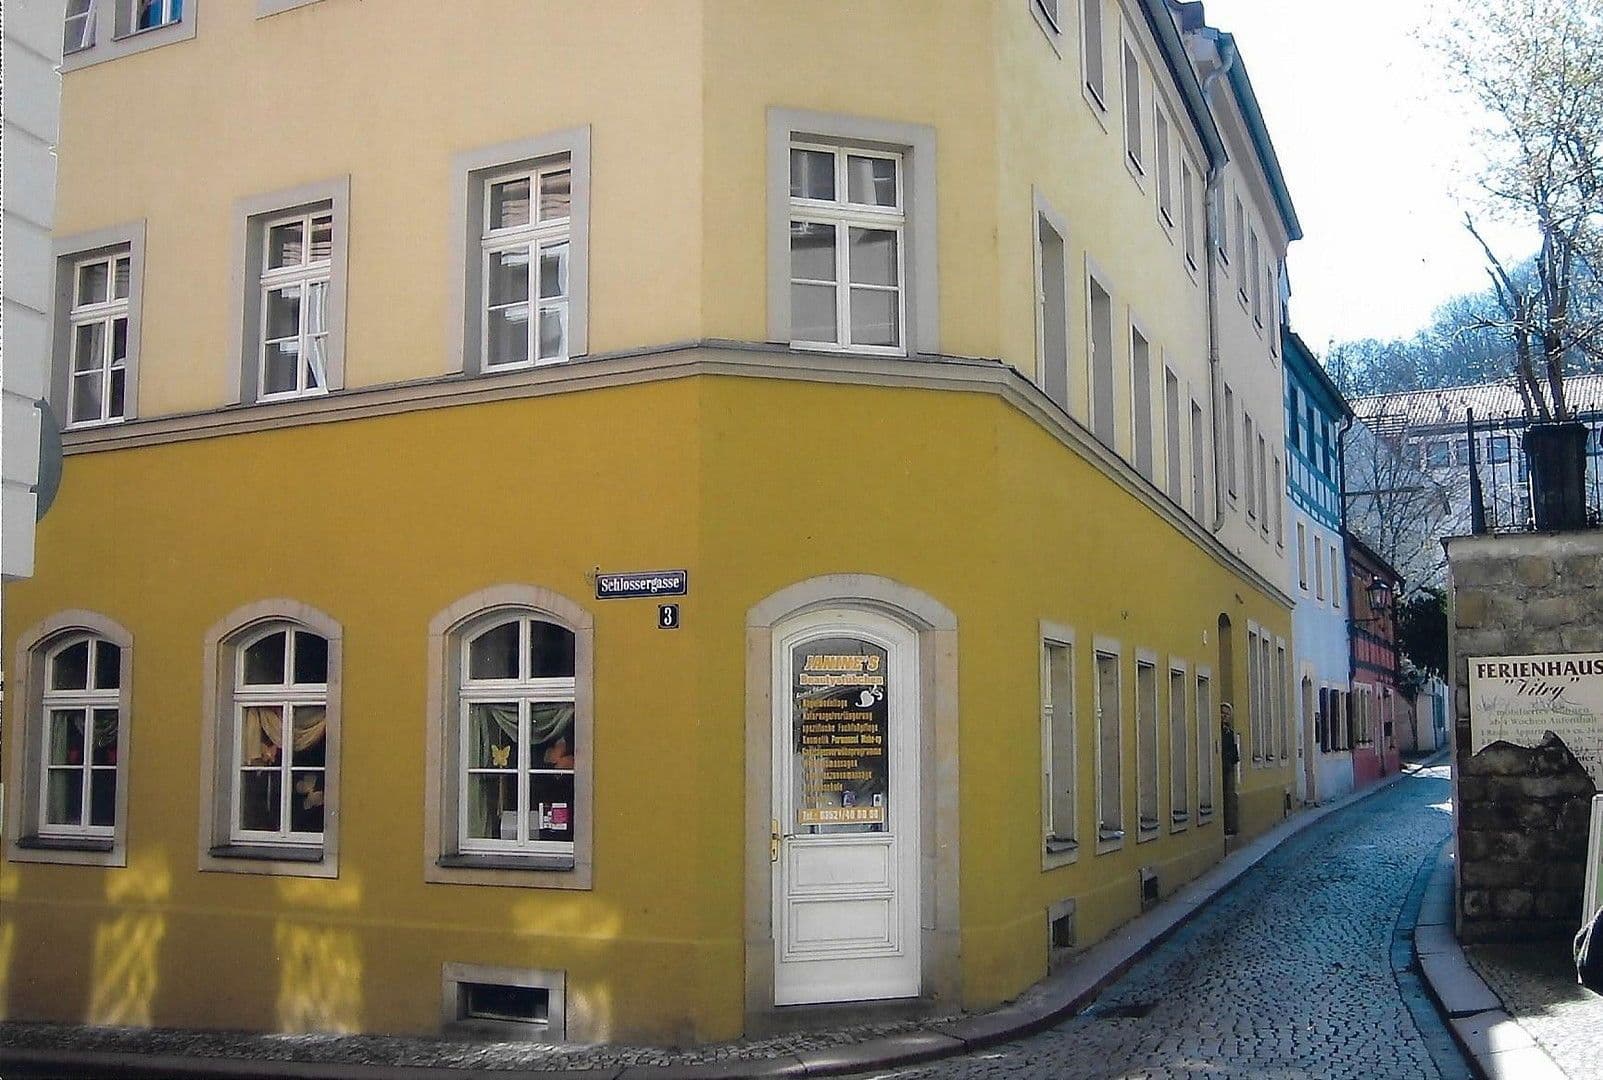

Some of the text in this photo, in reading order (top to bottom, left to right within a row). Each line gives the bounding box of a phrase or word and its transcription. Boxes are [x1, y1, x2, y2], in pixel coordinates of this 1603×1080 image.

[601, 577, 680, 593] Schlossergasse
[664, 607, 672, 625] 3
[1478, 660, 1603, 678] FERIENHAUS
